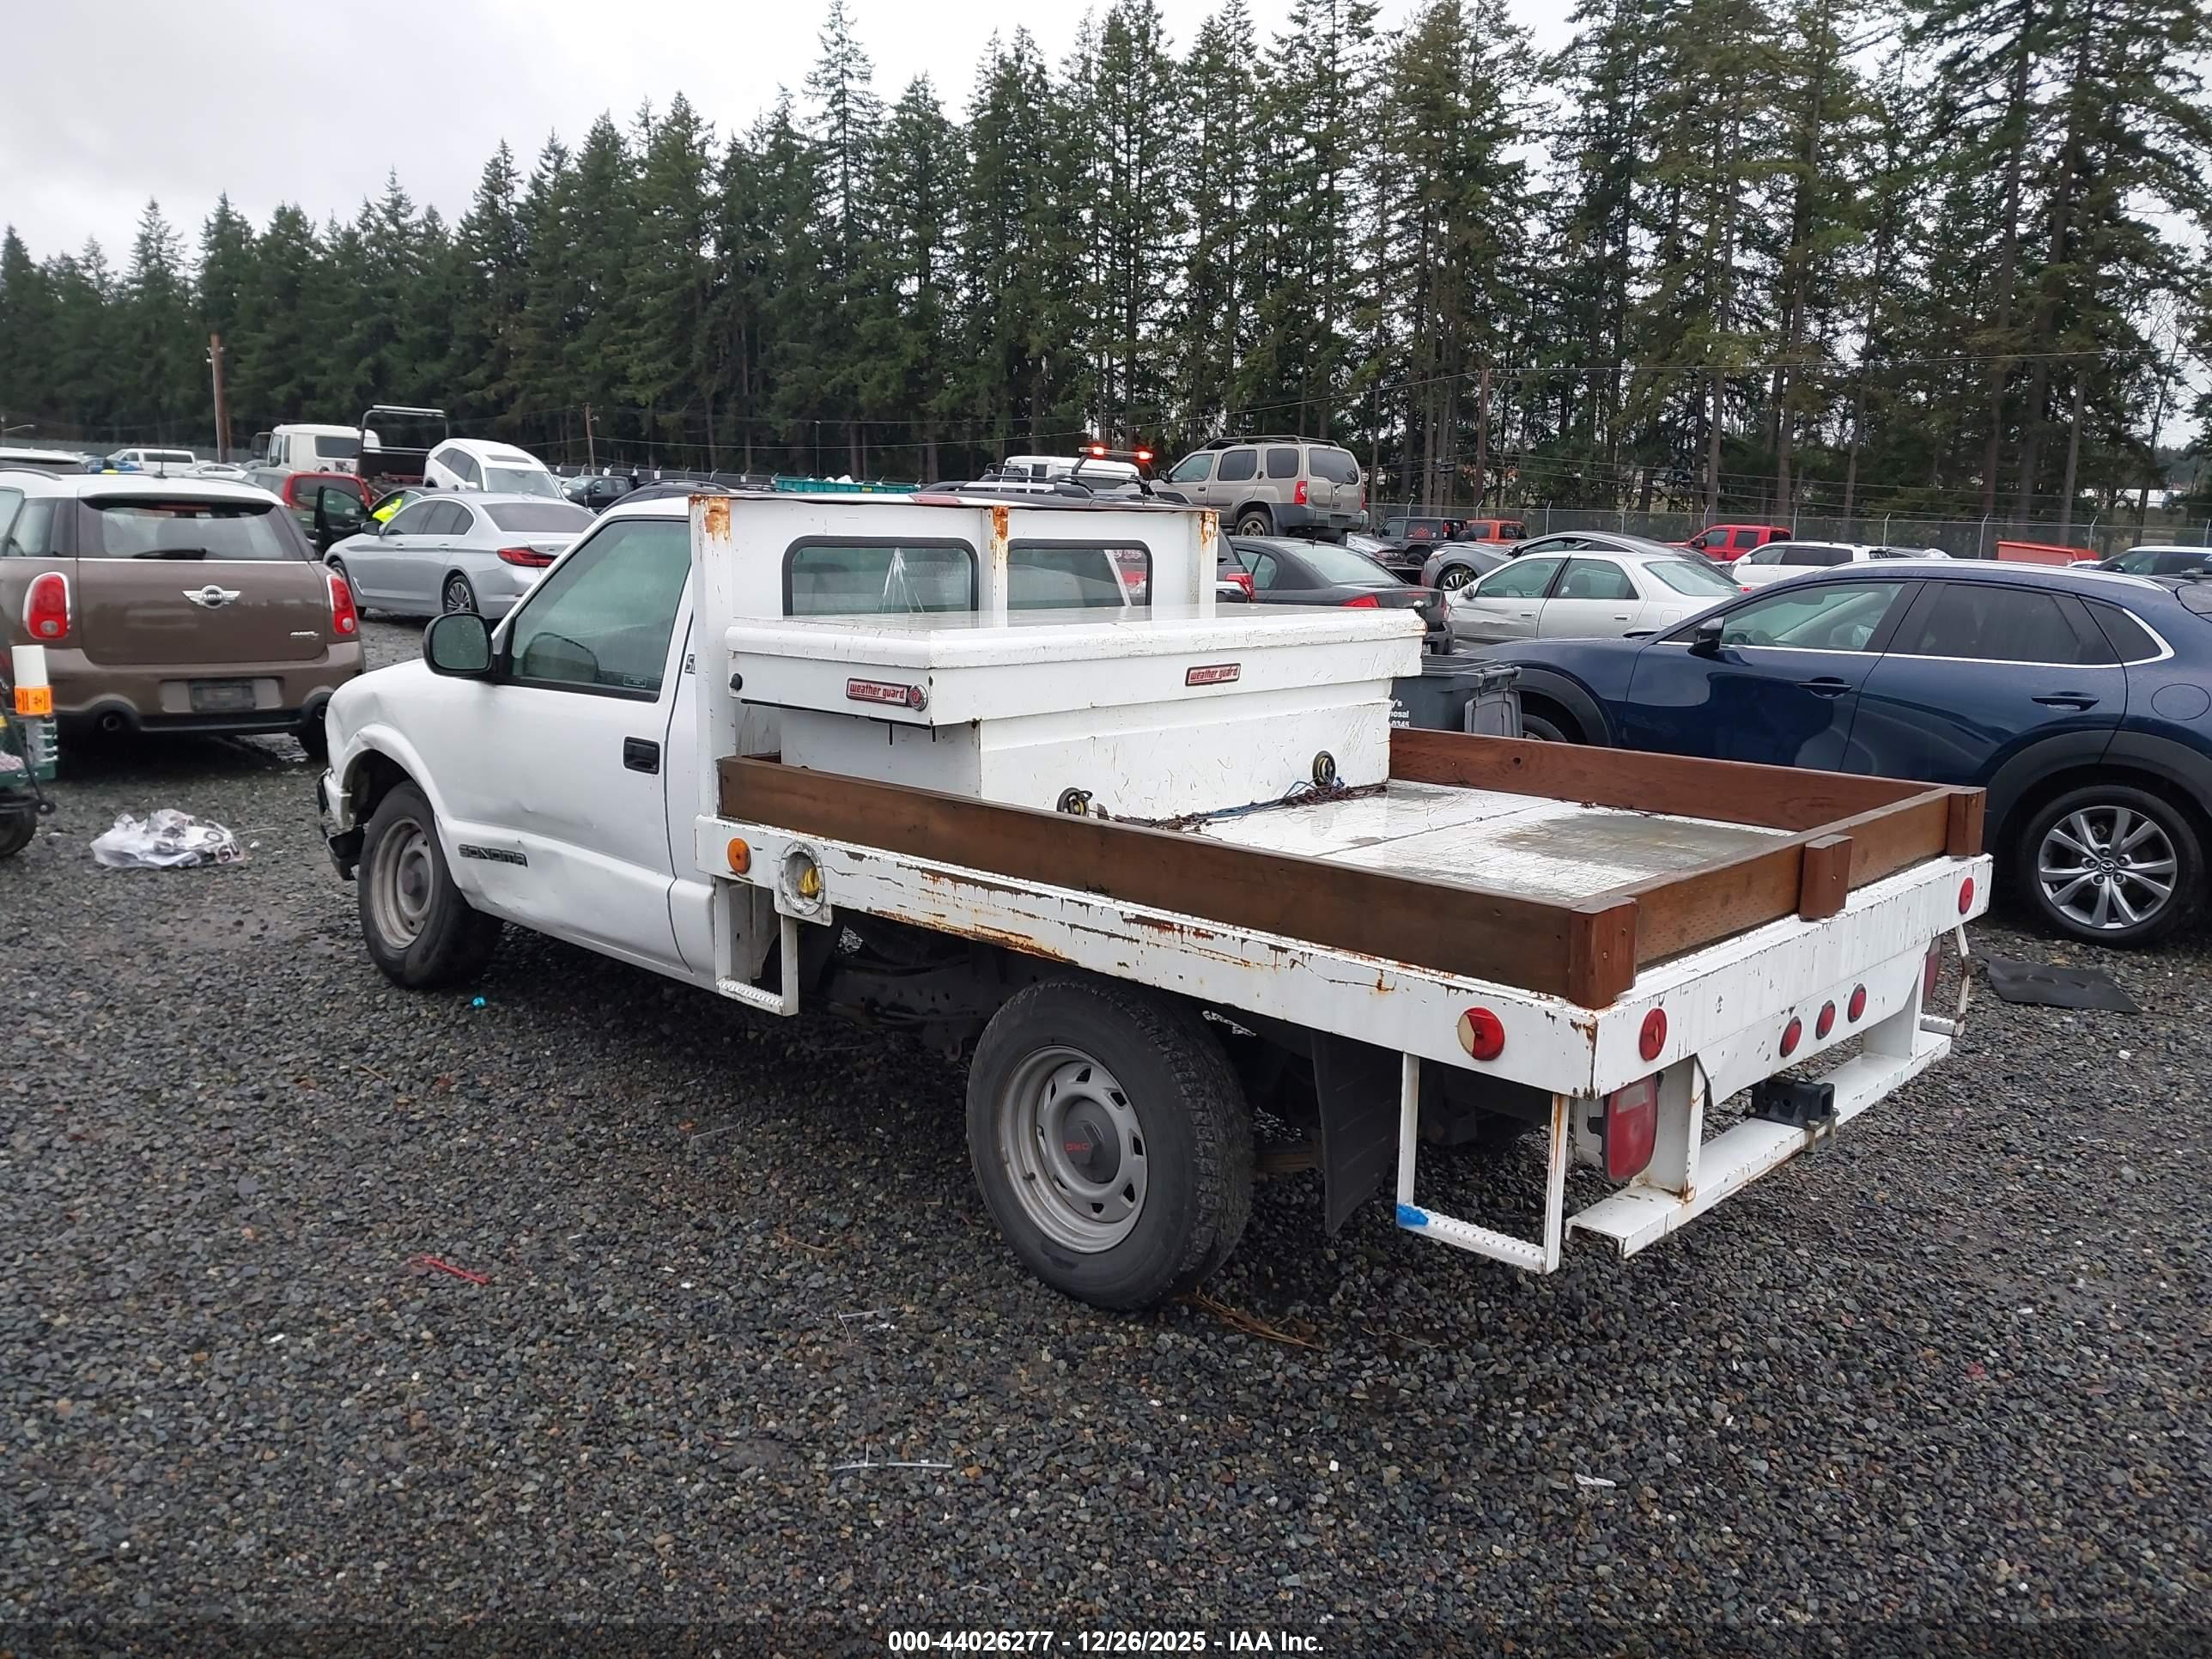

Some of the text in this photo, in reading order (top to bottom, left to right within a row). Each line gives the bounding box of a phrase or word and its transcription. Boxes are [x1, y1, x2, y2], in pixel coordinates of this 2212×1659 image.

[1190, 665, 1238, 681] weather guard
[849, 684, 905, 699] weather guard
[459, 844, 528, 867] SONOMA
